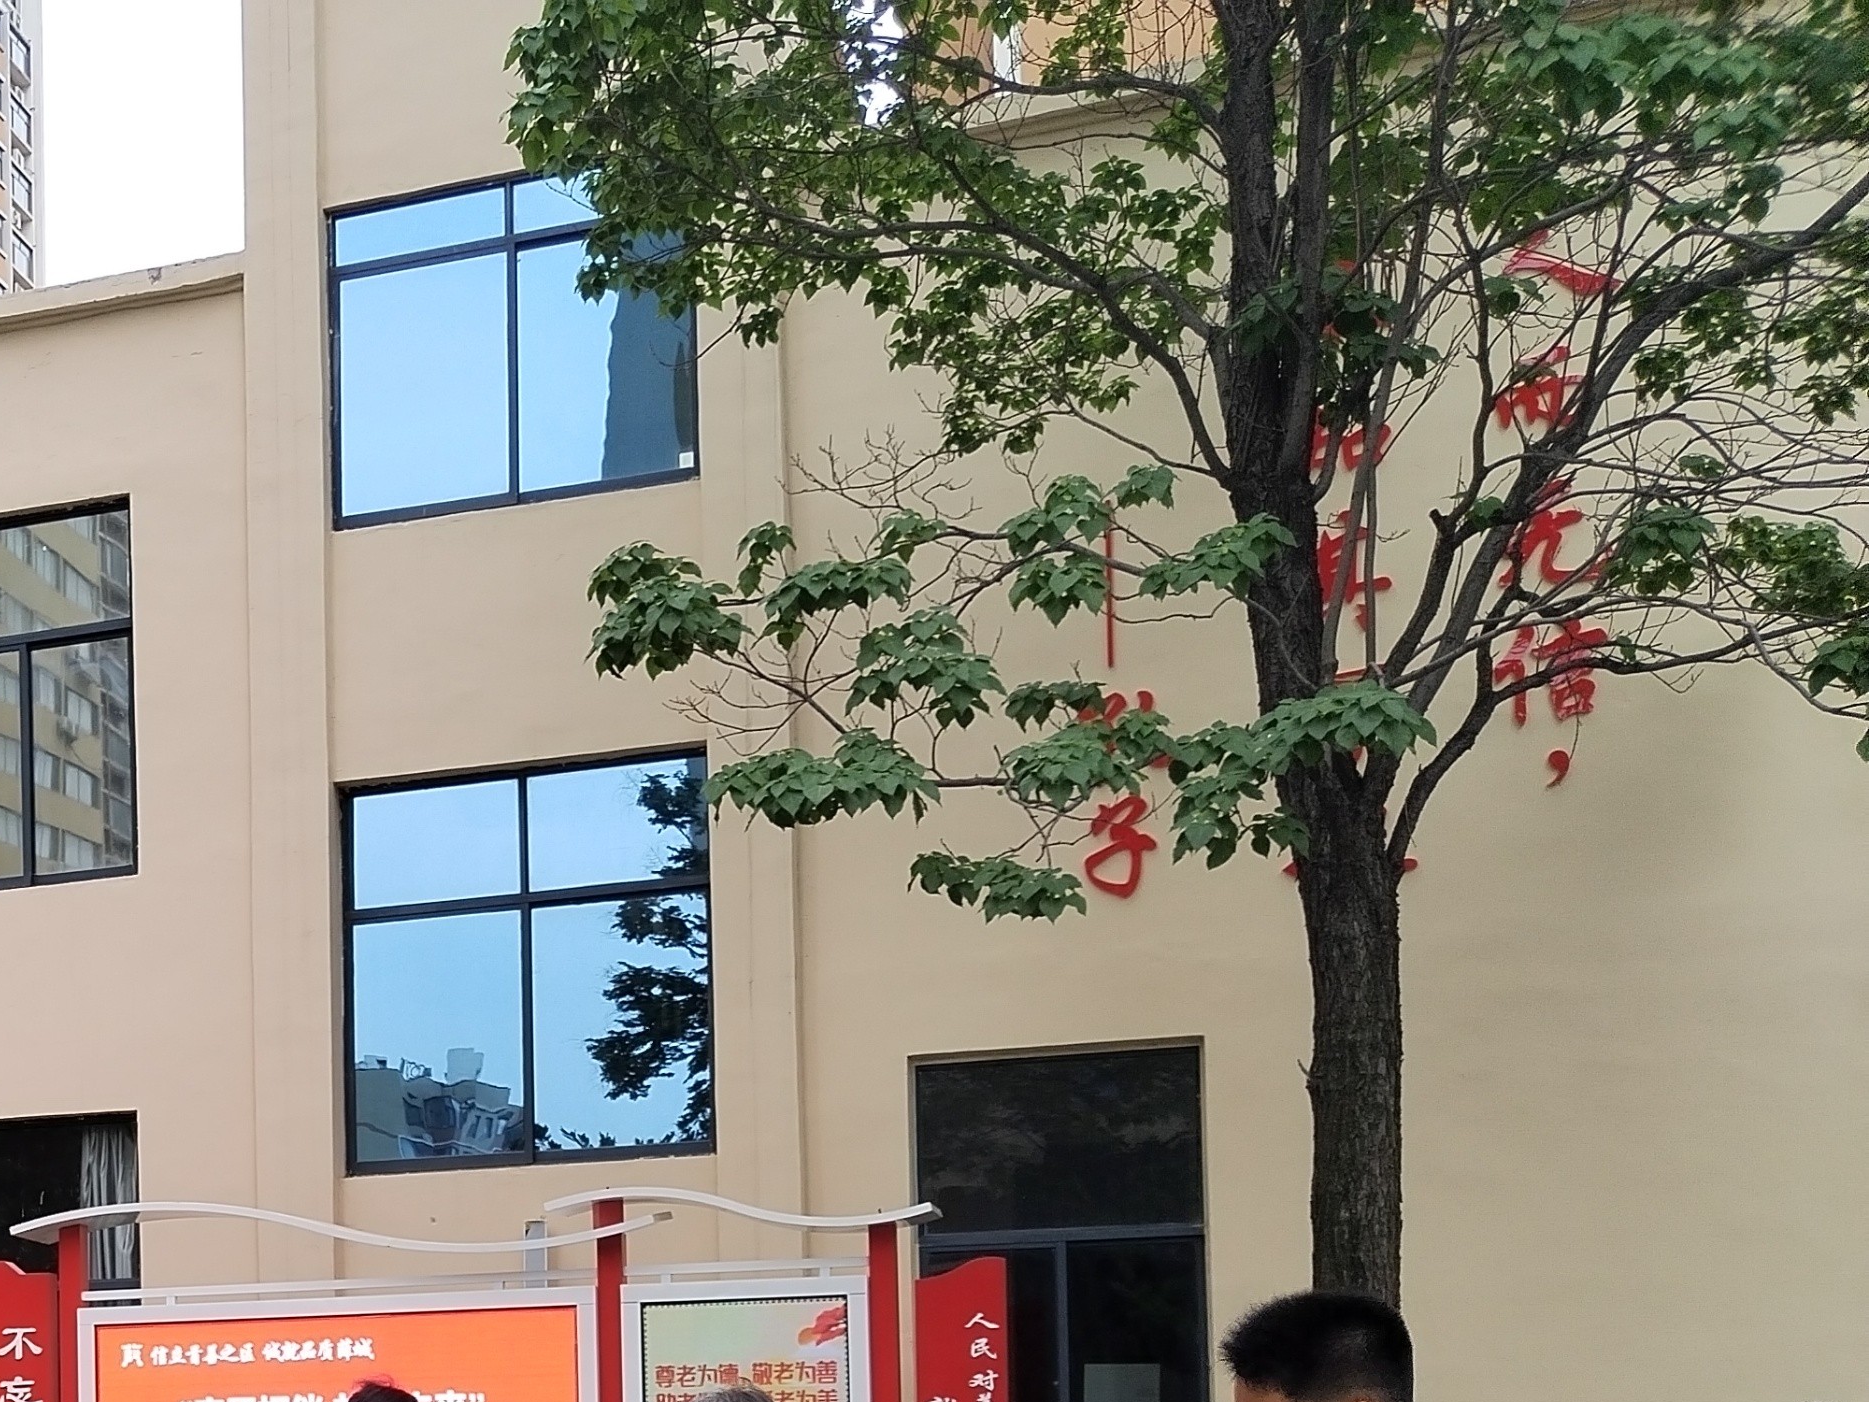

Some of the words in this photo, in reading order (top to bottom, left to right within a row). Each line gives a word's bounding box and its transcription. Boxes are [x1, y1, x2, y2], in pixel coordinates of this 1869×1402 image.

[655, 1363, 739, 1388] 尊老为德
[751, 1360, 838, 1386] 敬老为善
